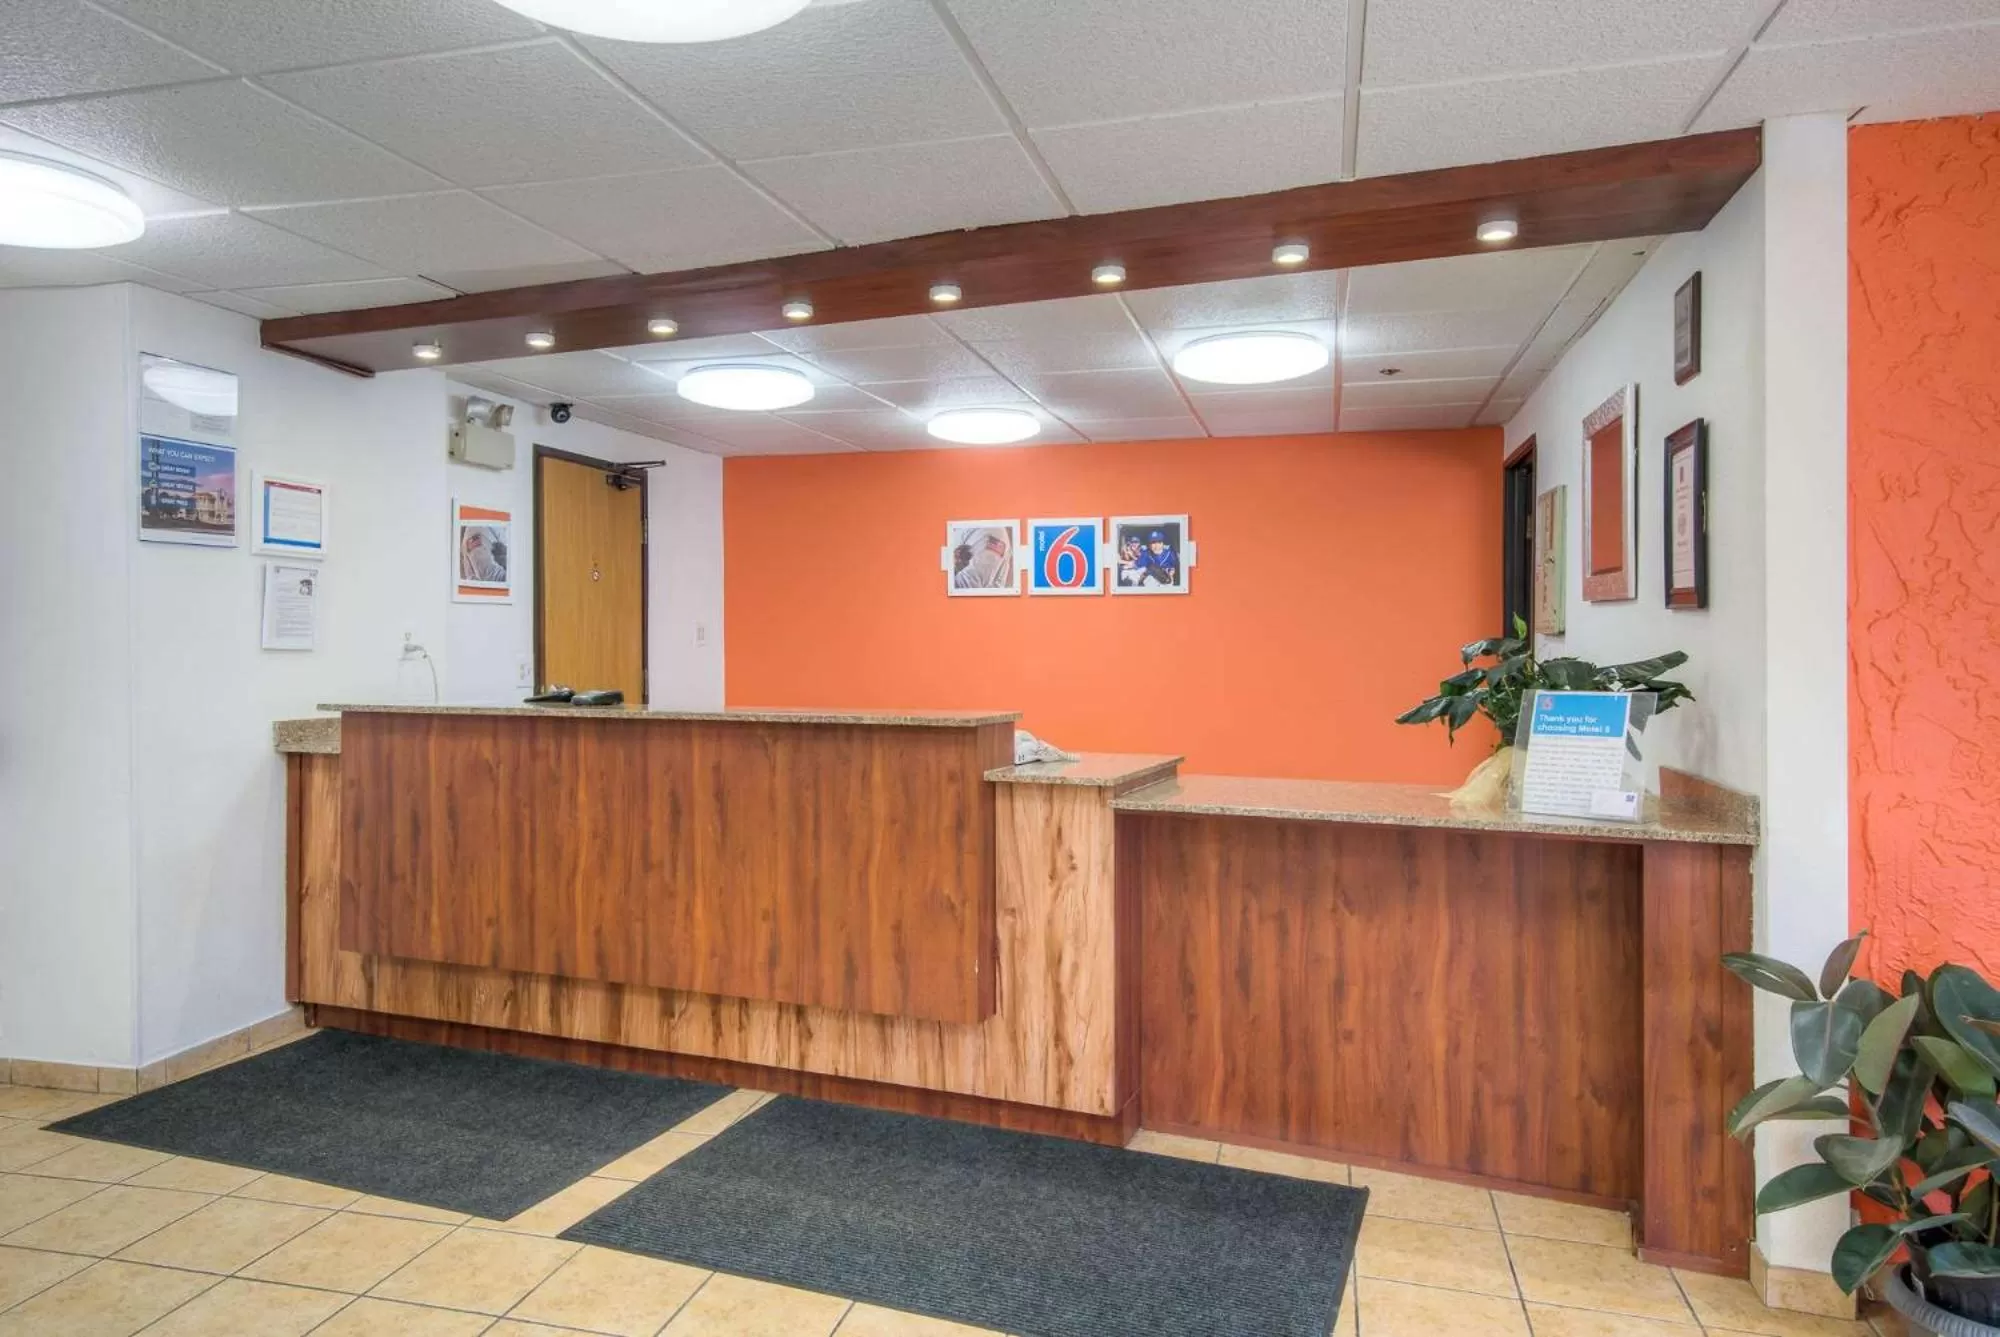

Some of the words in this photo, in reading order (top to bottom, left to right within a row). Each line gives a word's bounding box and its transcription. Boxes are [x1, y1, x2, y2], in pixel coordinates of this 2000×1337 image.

[1038, 530, 1046, 552] motel
[1044, 526, 1088, 587] 6
[1539, 713, 1565, 722] Thank
[1565, 716, 1583, 724] you
[1585, 715, 1598, 723] for
[1537, 723, 1577, 733] choosing
[1578, 725, 1603, 733] Motel
